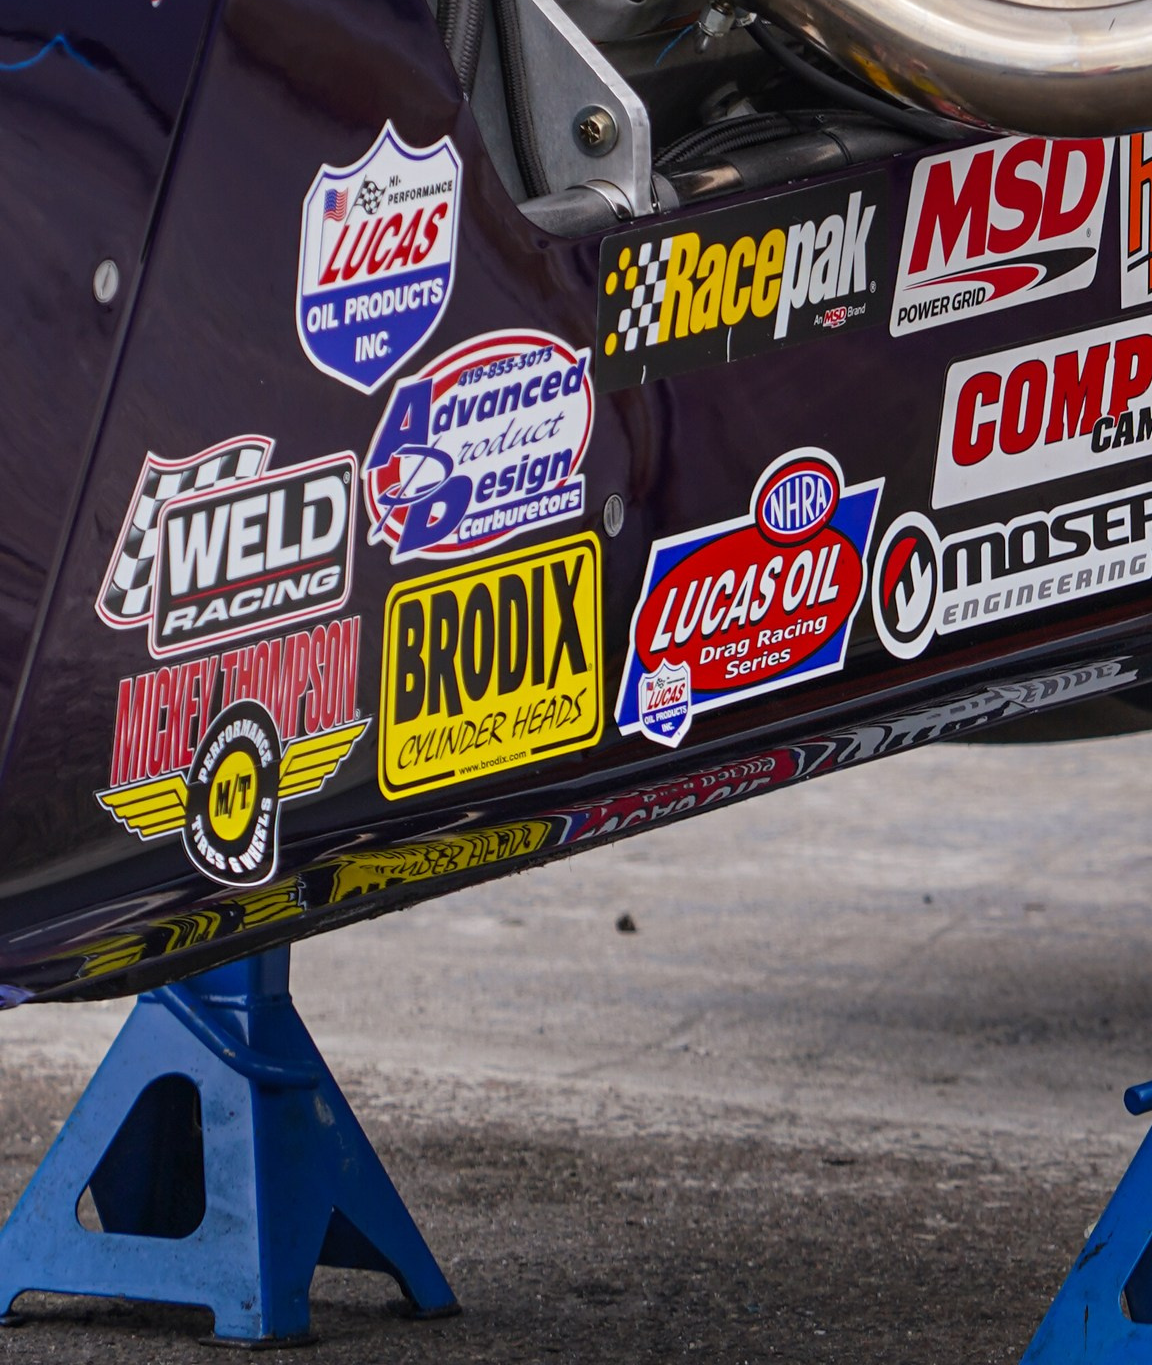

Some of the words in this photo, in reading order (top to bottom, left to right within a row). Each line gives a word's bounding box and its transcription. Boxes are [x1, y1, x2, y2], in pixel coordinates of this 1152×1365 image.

[387, 180, 453, 205] PERFORMANCE
[908, 137, 1106, 275] MSD
[318, 201, 448, 286] LUCAS
[657, 190, 877, 344] Racepak
[306, 303, 338, 333] OIL
[344, 277, 444, 324] PRODUCTS
[813, 314, 823, 326] An
[823, 307, 847, 325] MSD
[847, 303, 867, 317] Brand
[897, 295, 951, 327] POWER
[951, 286, 986, 310] GRID
[458, 345, 554, 387] 419-855-3073
[367, 357, 587, 471] Advanced
[372, 410, 565, 538] Product
[396, 447, 574, 556] Design
[769, 474, 828, 529] NHRA
[166, 473, 347, 597] WELD
[458, 488, 581, 541] Carburetors
[161, 564, 342, 637] RACING
[650, 555, 784, 655] LUCAS
[782, 543, 841, 612] OIL
[942, 554, 1147, 626] ENGINEERING
[393, 555, 589, 727] BRODIX
[699, 638, 750, 665] Drag
[756, 615, 828, 648] Racing
[724, 647, 791, 679] Series
[109, 654, 217, 788] MICKEY
[218, 615, 361, 743] THOMPSON
[397, 711, 507, 770] CYLINDER
[513, 687, 588, 741] HEADS
[644, 716, 655, 726] OIL
[655, 705, 687, 722] PRODUCTS
[647, 682, 685, 710] LUCAS
[197, 718, 275, 784] PERFORMANCE
[458, 749, 527, 776] www.brodix.com
[214, 773, 252, 819] M/T
[190, 814, 227, 871] TIRES
[228, 855, 244, 874] &
[239, 796, 273, 871] WHEELS
